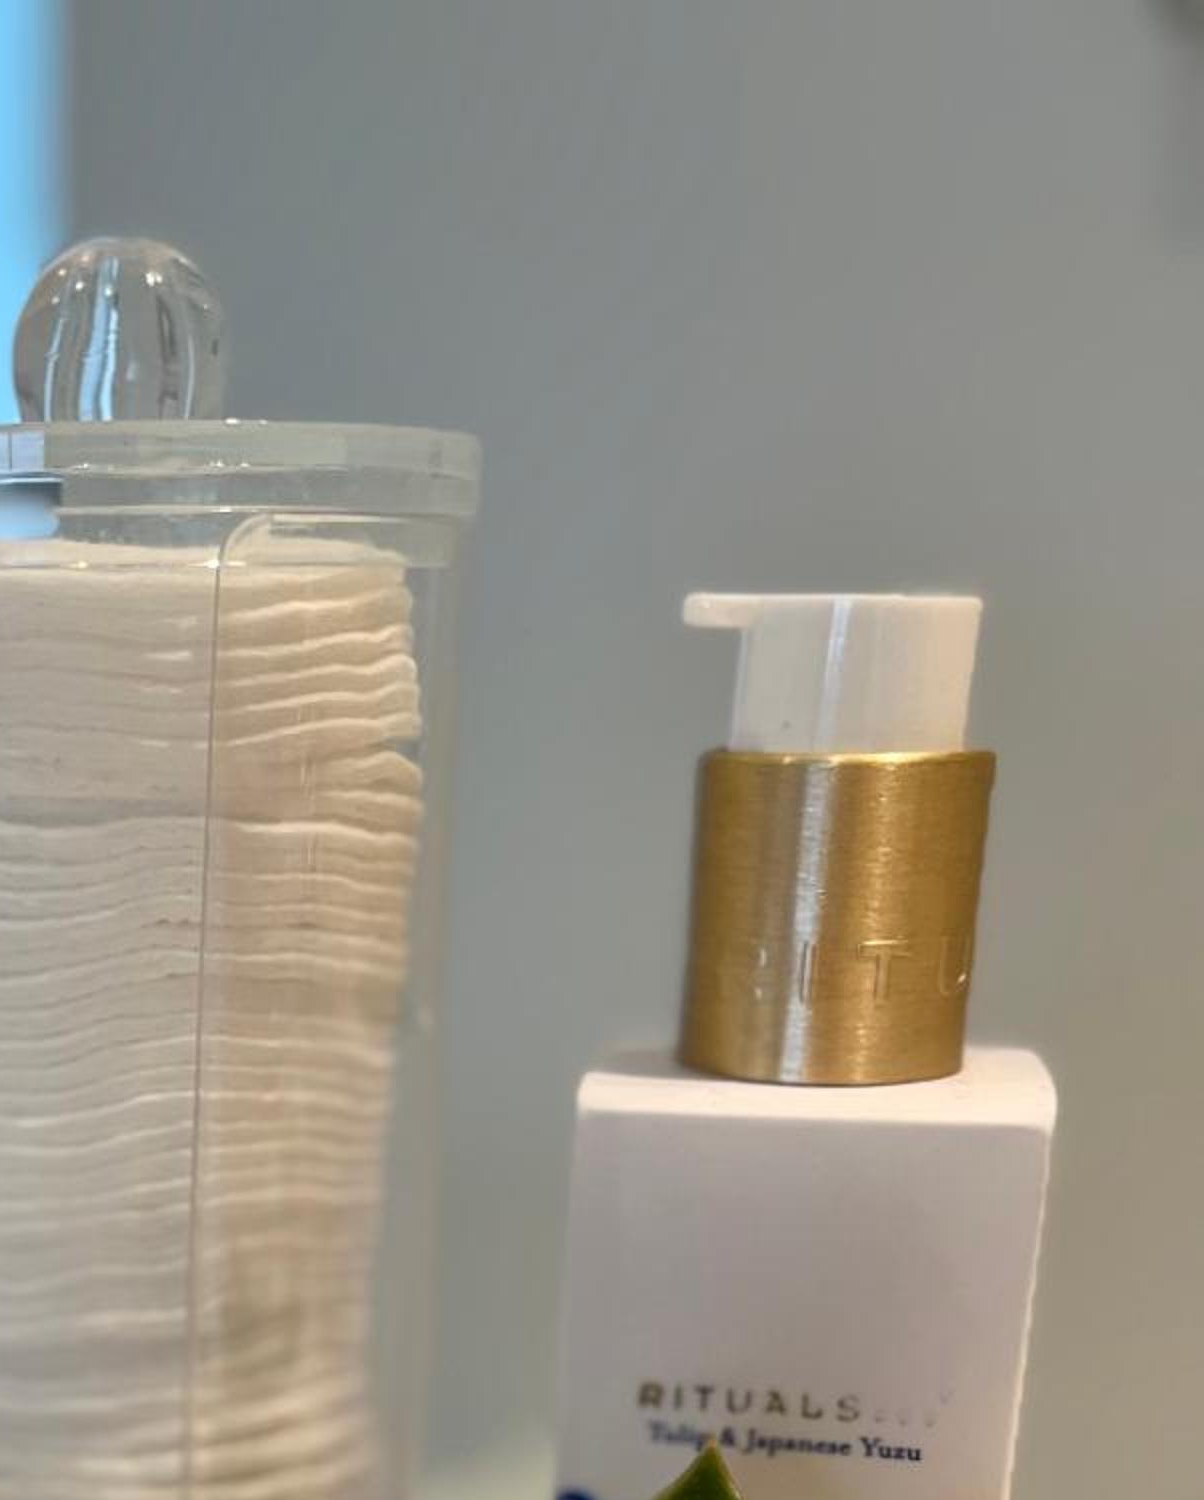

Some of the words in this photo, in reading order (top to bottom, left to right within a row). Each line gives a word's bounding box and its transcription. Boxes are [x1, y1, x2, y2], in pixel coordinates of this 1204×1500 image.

[720, 1427, 736, 1447] &
[741, 1428, 852, 1458] Japanese
[860, 1436, 923, 1461] Yuzu
